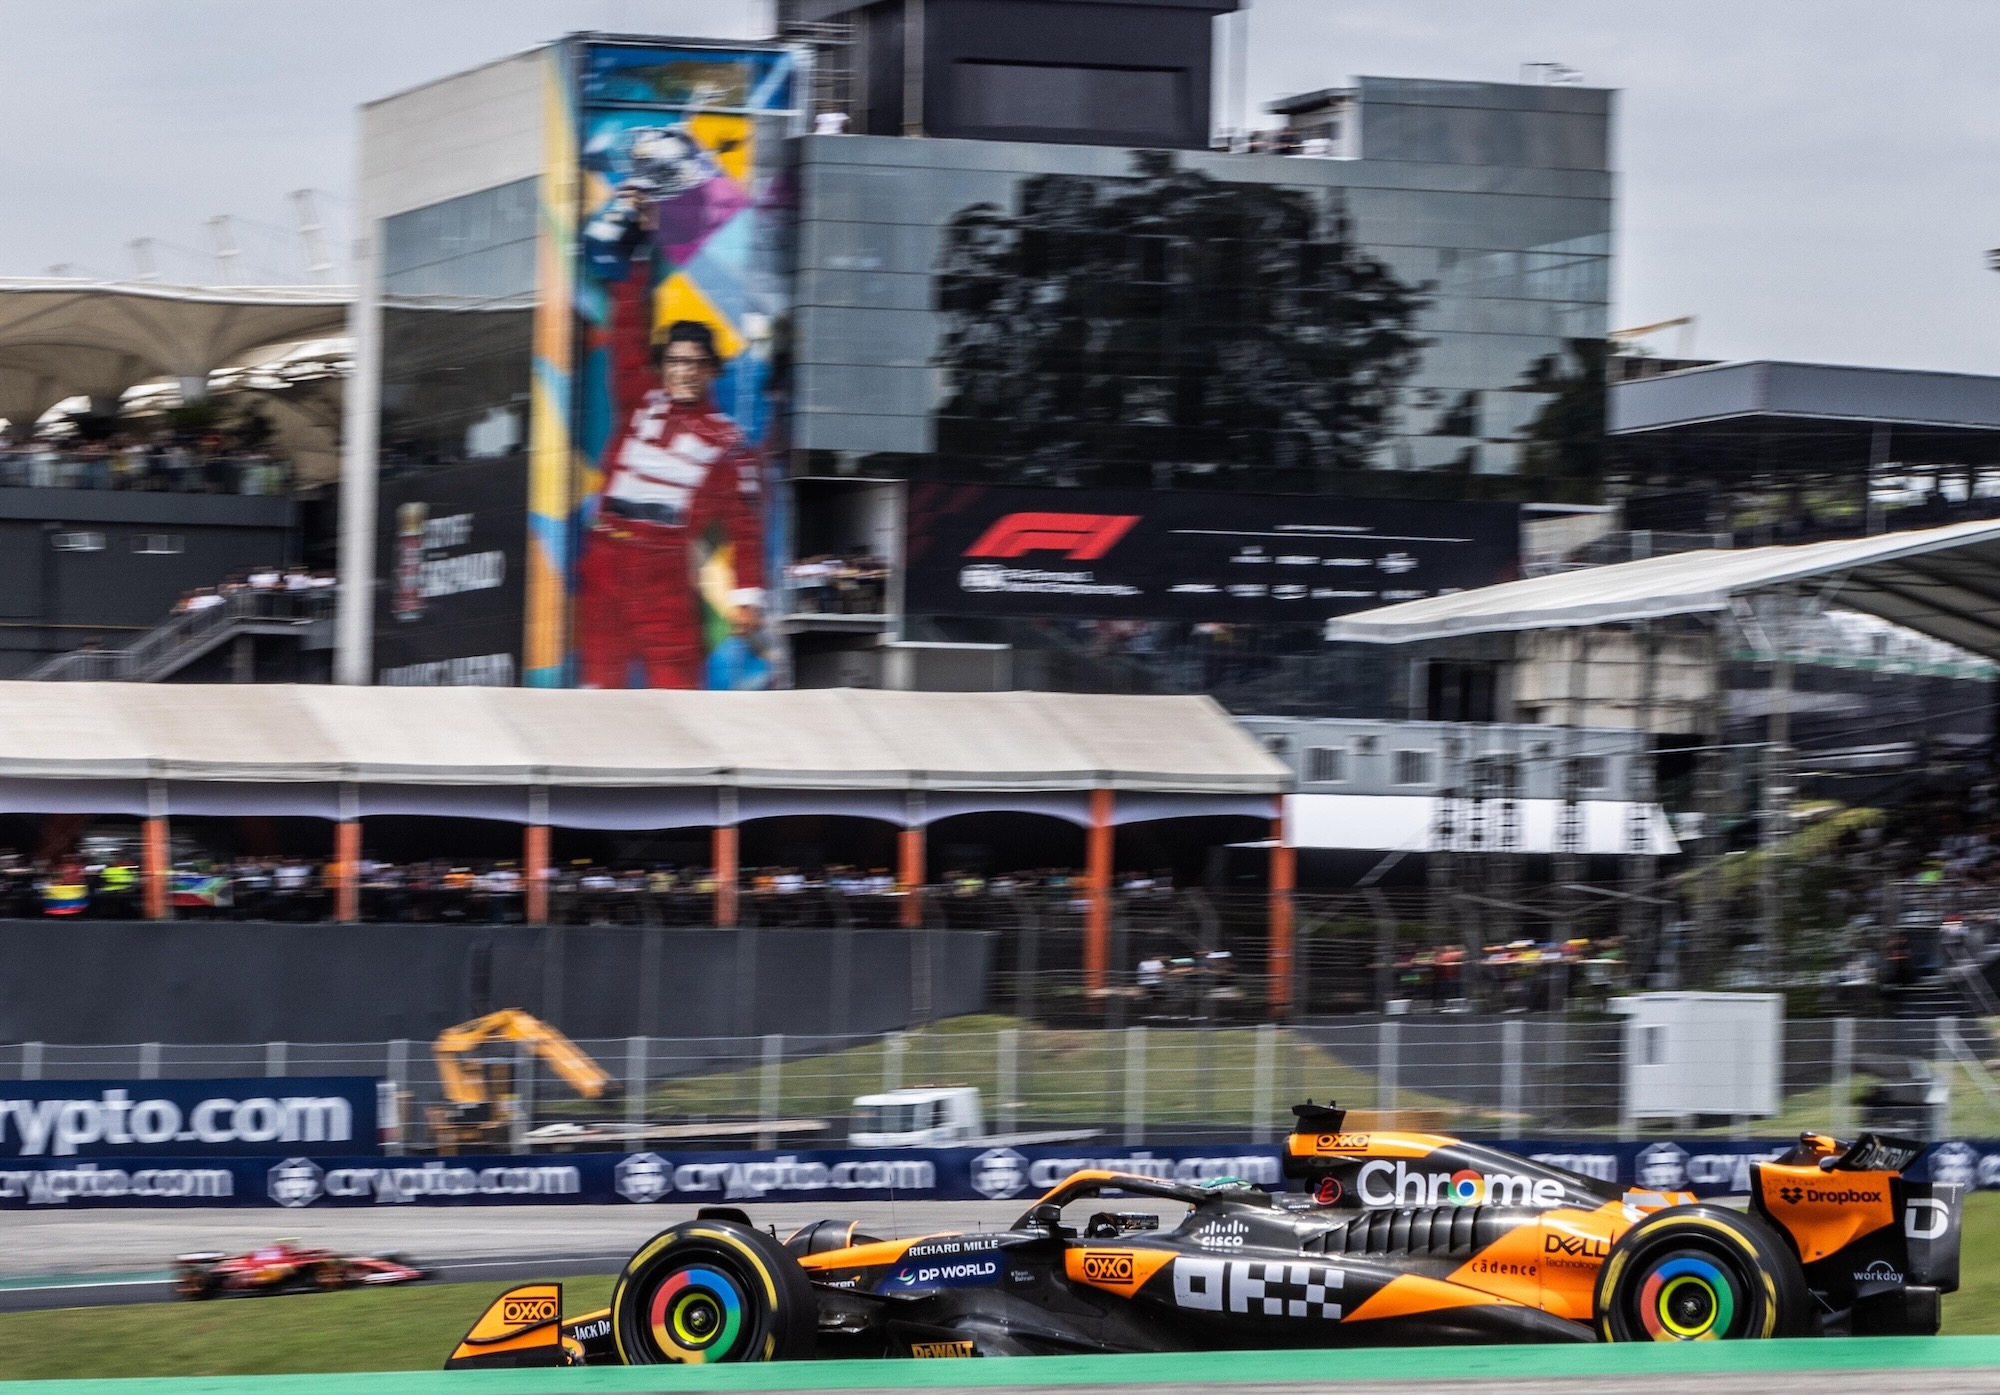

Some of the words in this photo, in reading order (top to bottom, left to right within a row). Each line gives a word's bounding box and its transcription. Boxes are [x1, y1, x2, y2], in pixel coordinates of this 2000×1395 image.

[1318, 1135, 1369, 1147] OXXO
[1357, 1159, 1565, 1207] Chrome
[1808, 1189, 1881, 1205] Dropbox
[909, 1244, 960, 1257] RICHARD
[964, 1240, 999, 1251] MILLE
[1545, 1234, 1608, 1258] DELL
[919, 1267, 941, 1282] DP
[941, 1262, 996, 1279] WORLD
[1085, 1258, 1132, 1278] OXXO
[1853, 1269, 1904, 1283] workday
[1173, 1257, 1345, 1319] OKX
[505, 1301, 556, 1321] OXXO
